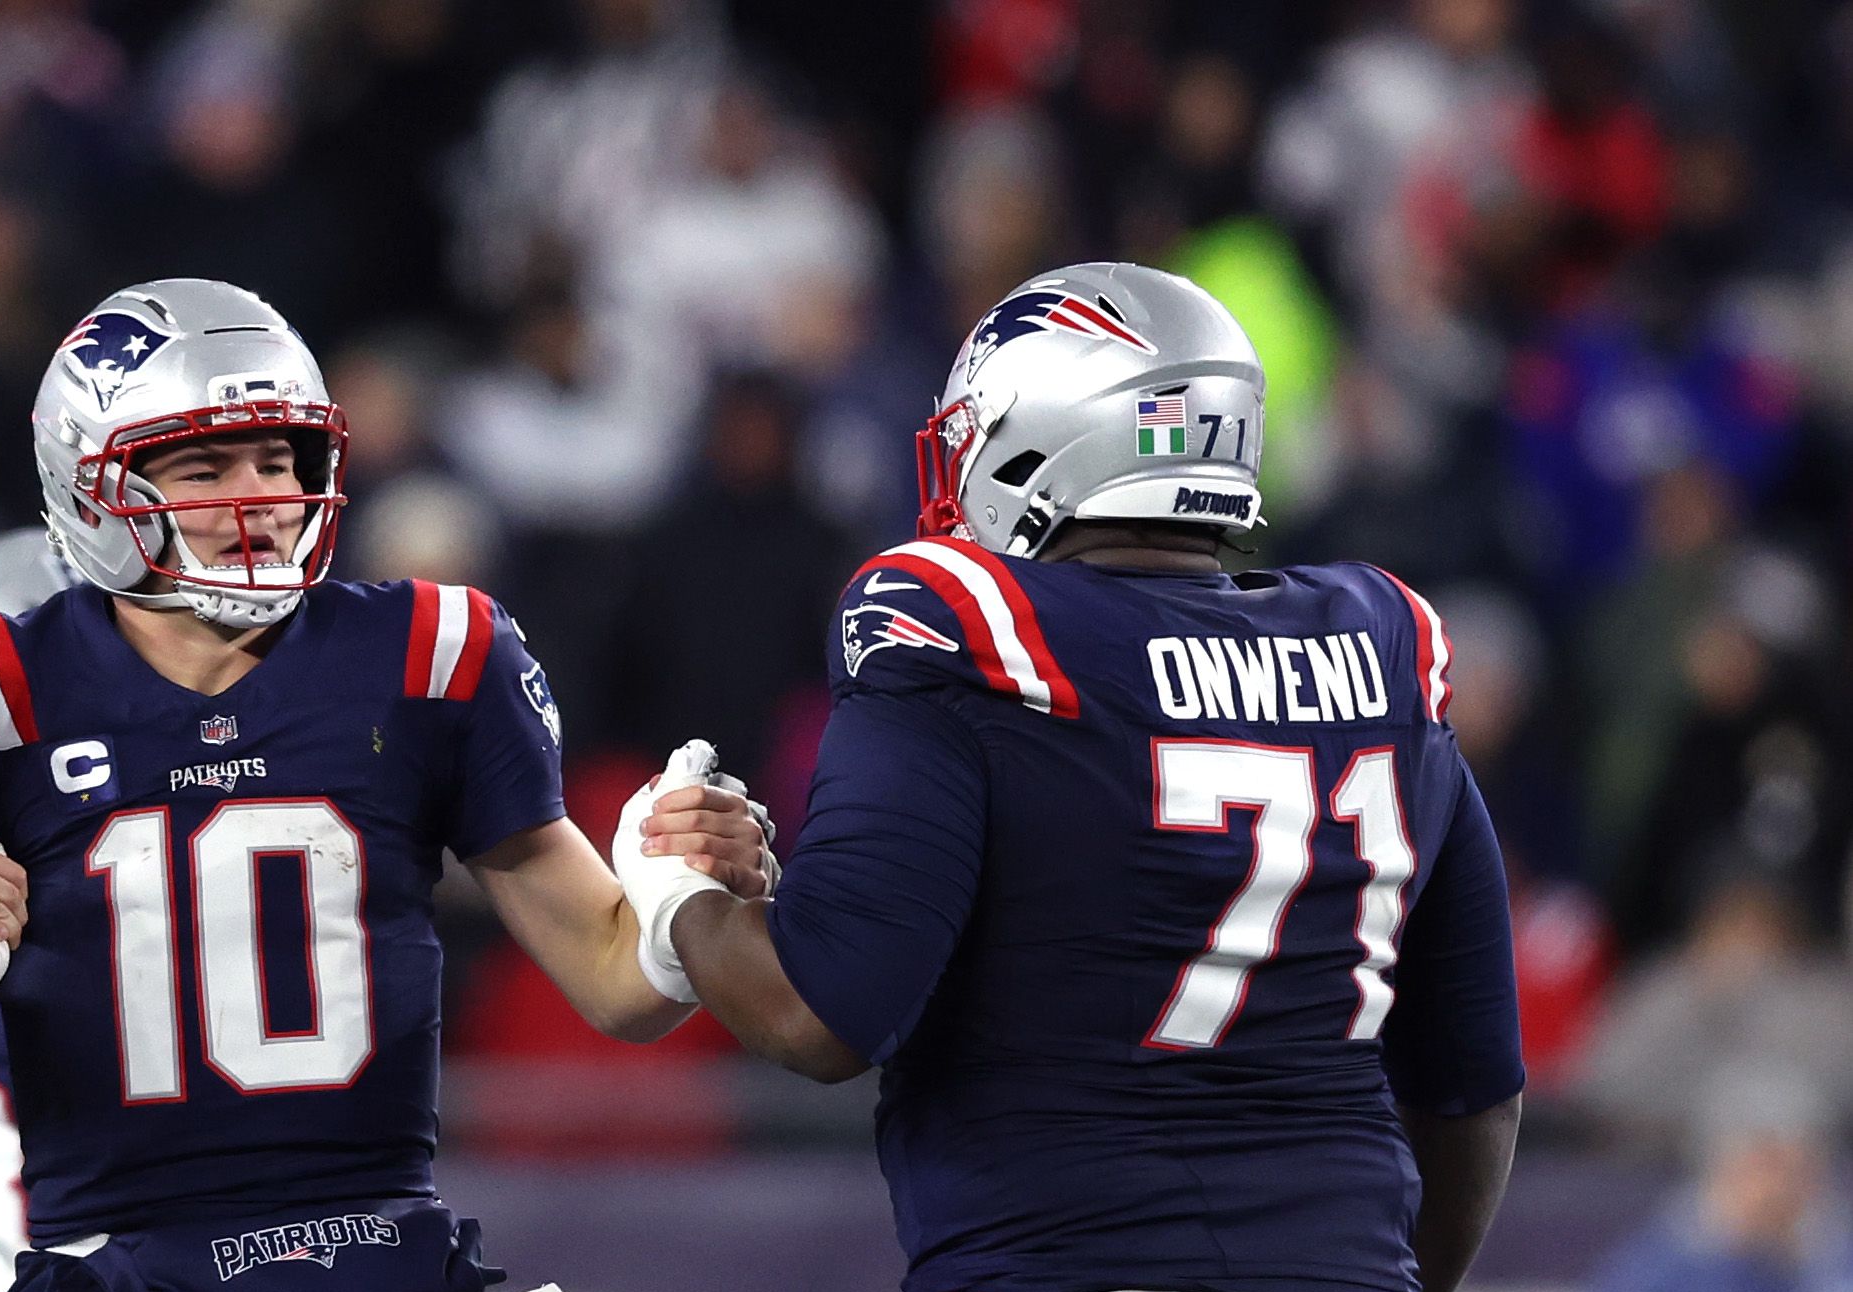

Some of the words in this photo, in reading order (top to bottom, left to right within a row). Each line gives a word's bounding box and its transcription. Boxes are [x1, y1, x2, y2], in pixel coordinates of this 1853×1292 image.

[1198, 414, 1246, 461] 71
[1146, 632, 1389, 723] ONWENU
[50, 740, 112, 794] C
[170, 757, 268, 792] PATRIOTS
[1141, 735, 1419, 1050] 71
[84, 797, 376, 1107] 10
[211, 1214, 401, 1281] PATRIOTS
